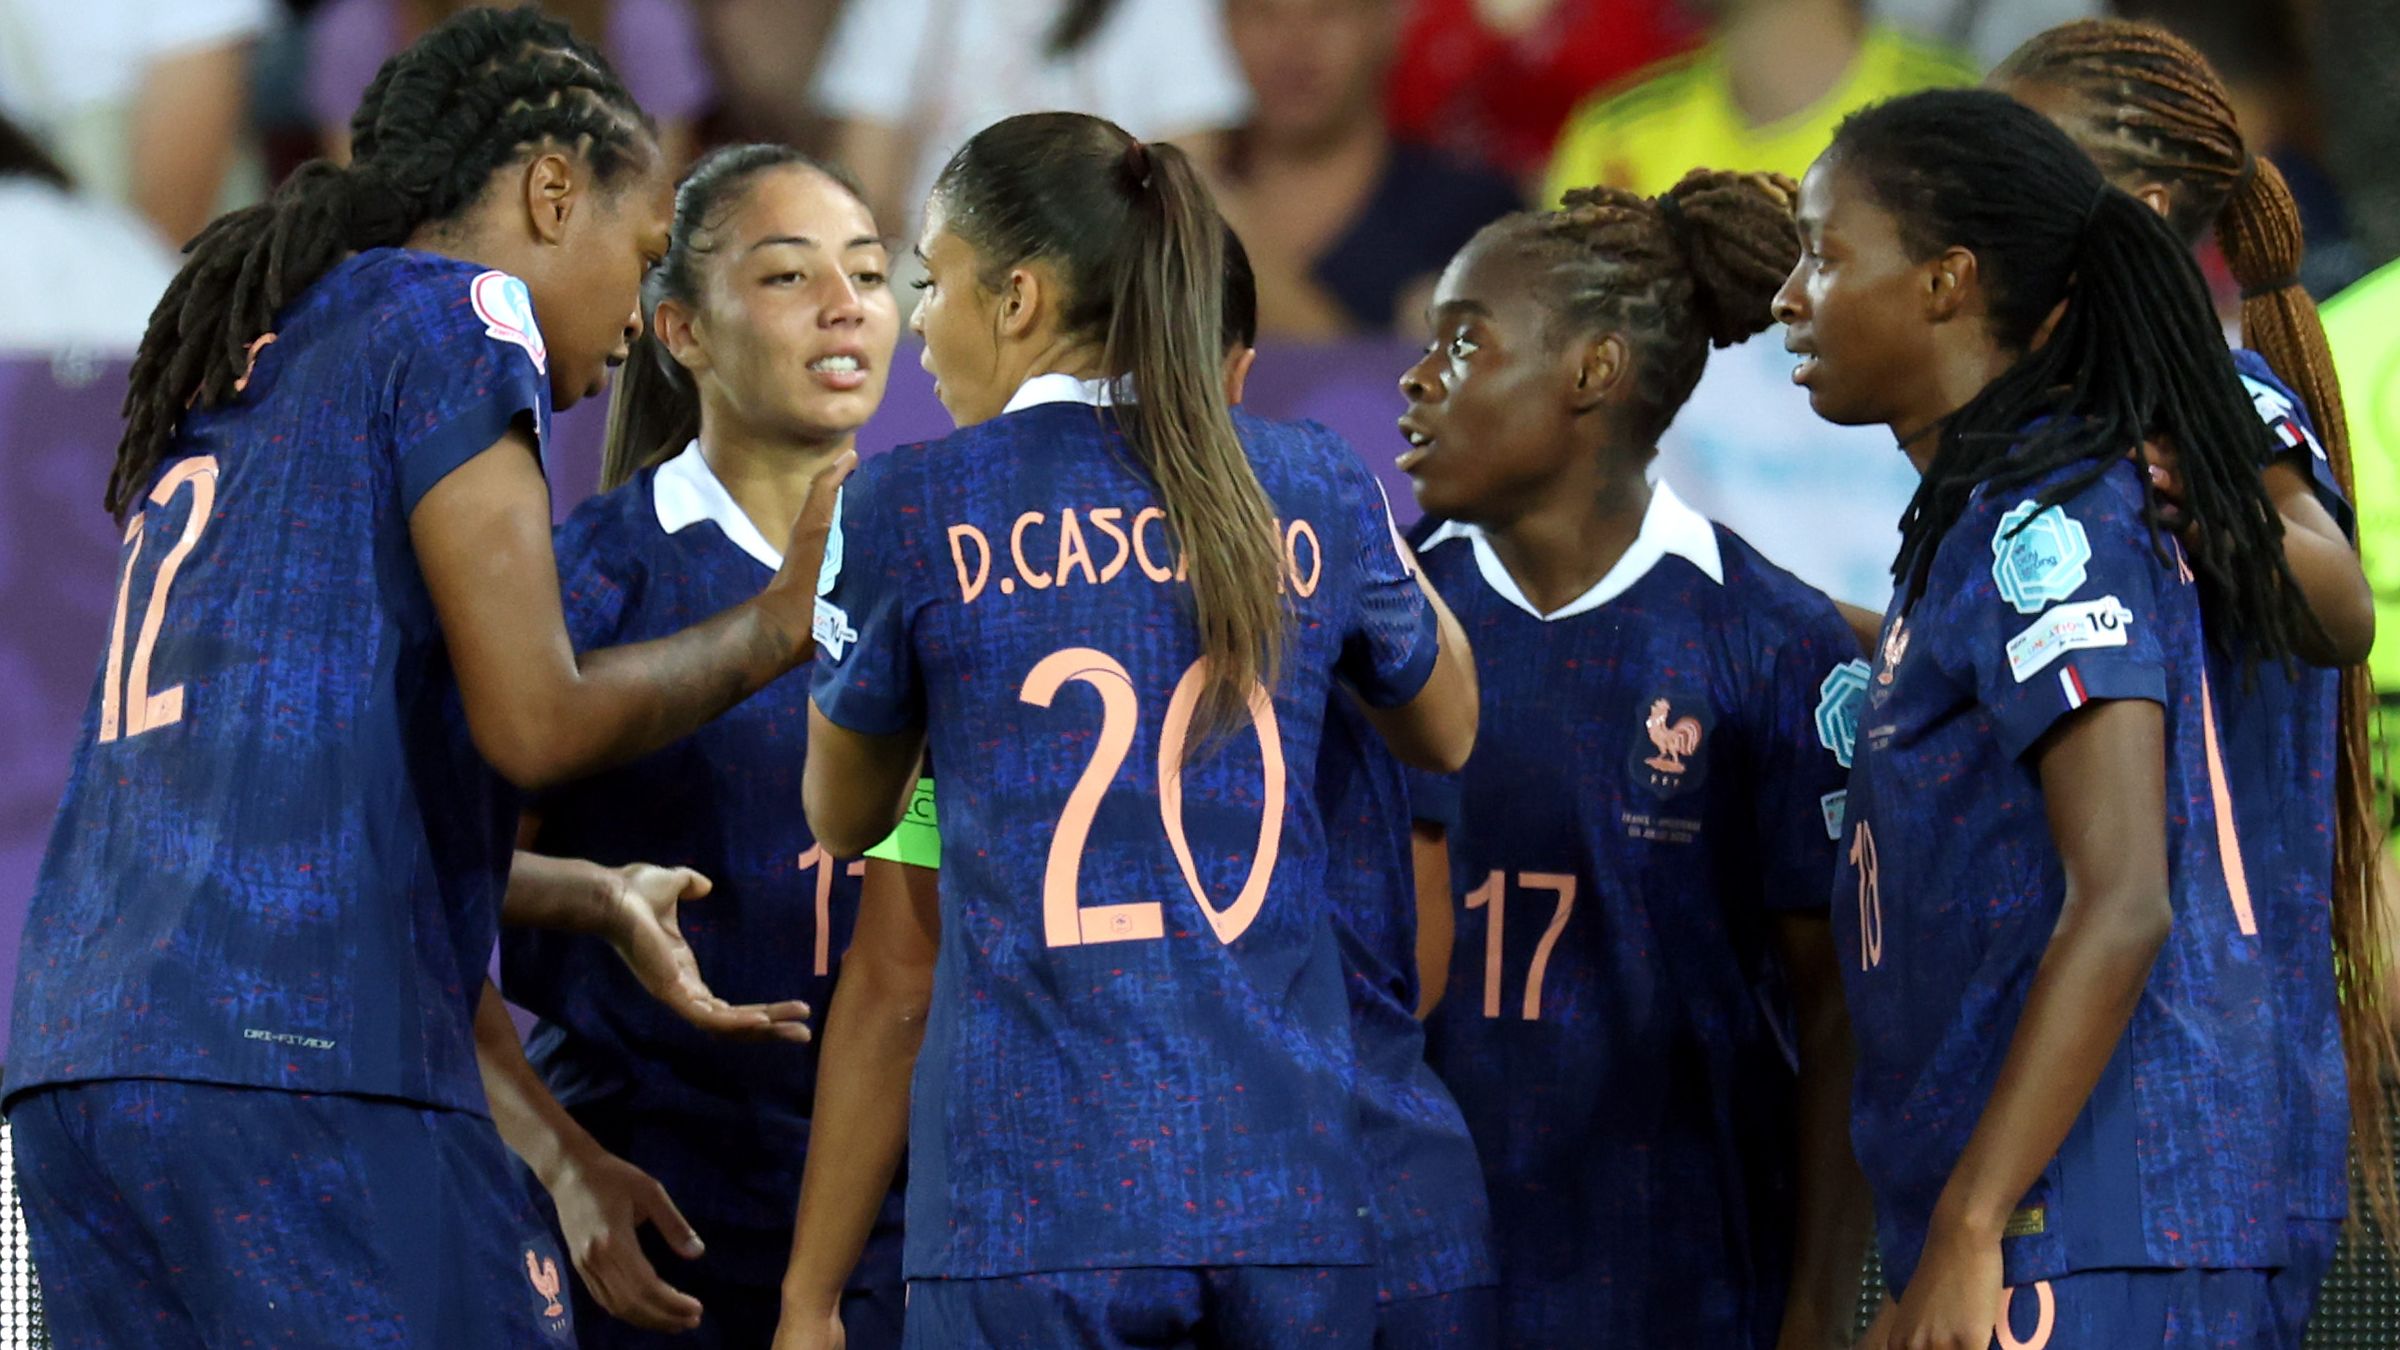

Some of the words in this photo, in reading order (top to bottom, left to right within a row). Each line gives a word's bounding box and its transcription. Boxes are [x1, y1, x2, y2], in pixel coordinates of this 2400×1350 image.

[100, 455, 219, 744] 12
[2086, 609, 2118, 631] 10
[1019, 646, 1286, 947] 20
[798, 841, 866, 976] 1
[1464, 869, 1577, 1020] 17
[1849, 818, 1882, 972] 18
